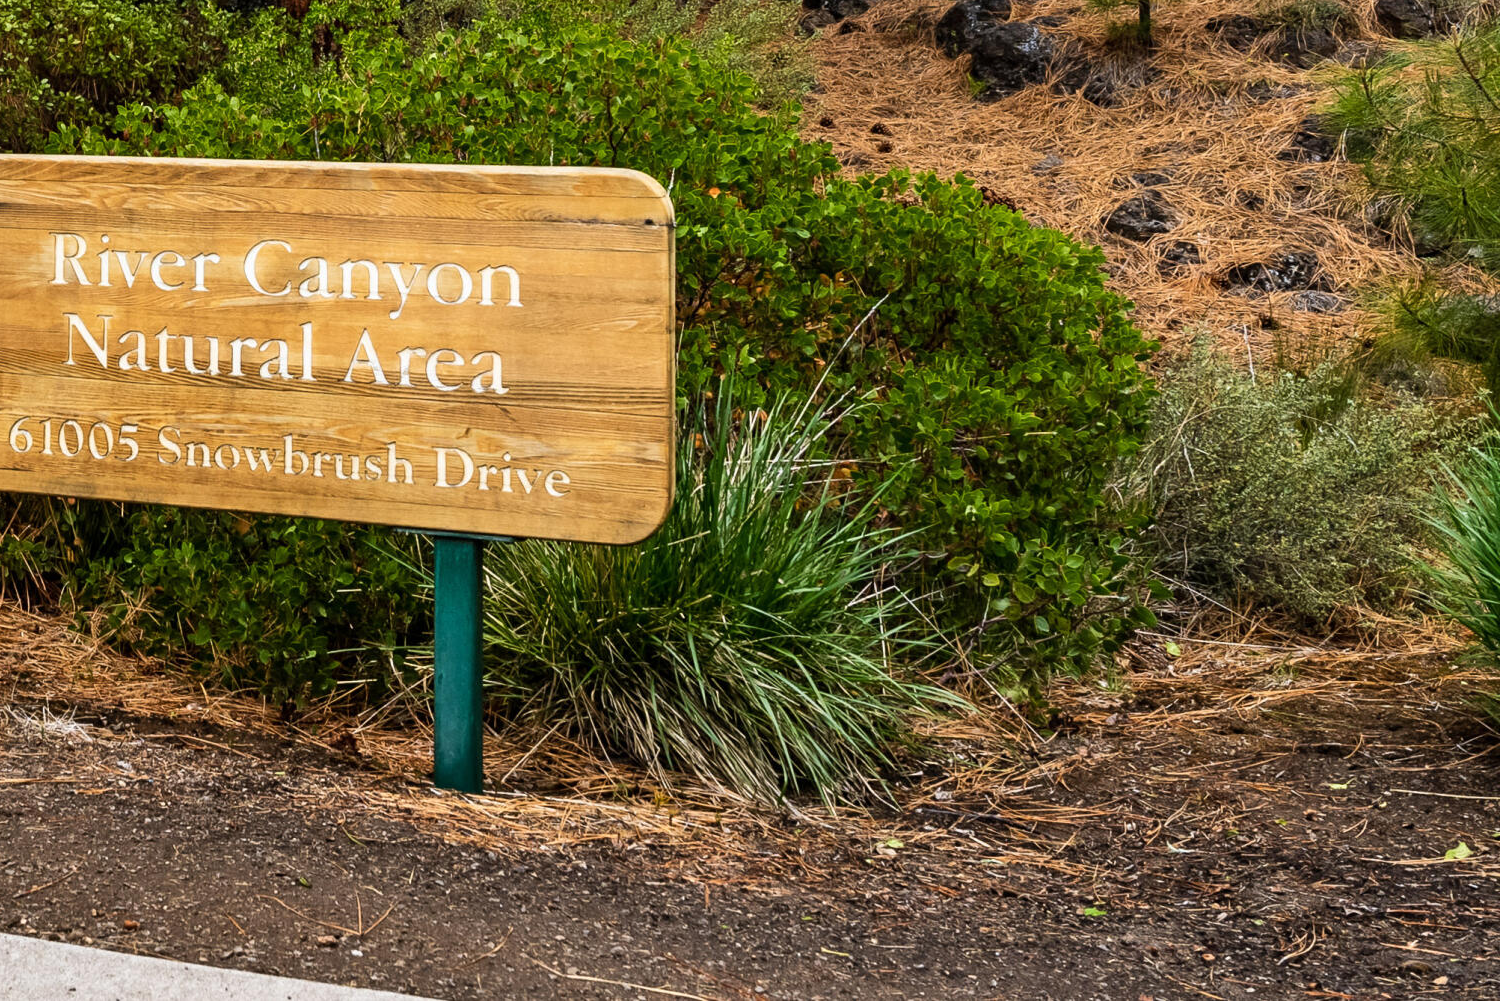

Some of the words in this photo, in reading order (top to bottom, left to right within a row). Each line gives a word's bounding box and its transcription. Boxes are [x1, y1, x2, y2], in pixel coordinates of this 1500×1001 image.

[49, 231, 220, 291] River
[243, 239, 523, 319] Canyon
[63, 312, 316, 381] Natural
[344, 328, 509, 394] Area
[9, 416, 139, 462] 61005
[158, 425, 414, 485] Snowbrush
[434, 447, 571, 497] Drive
